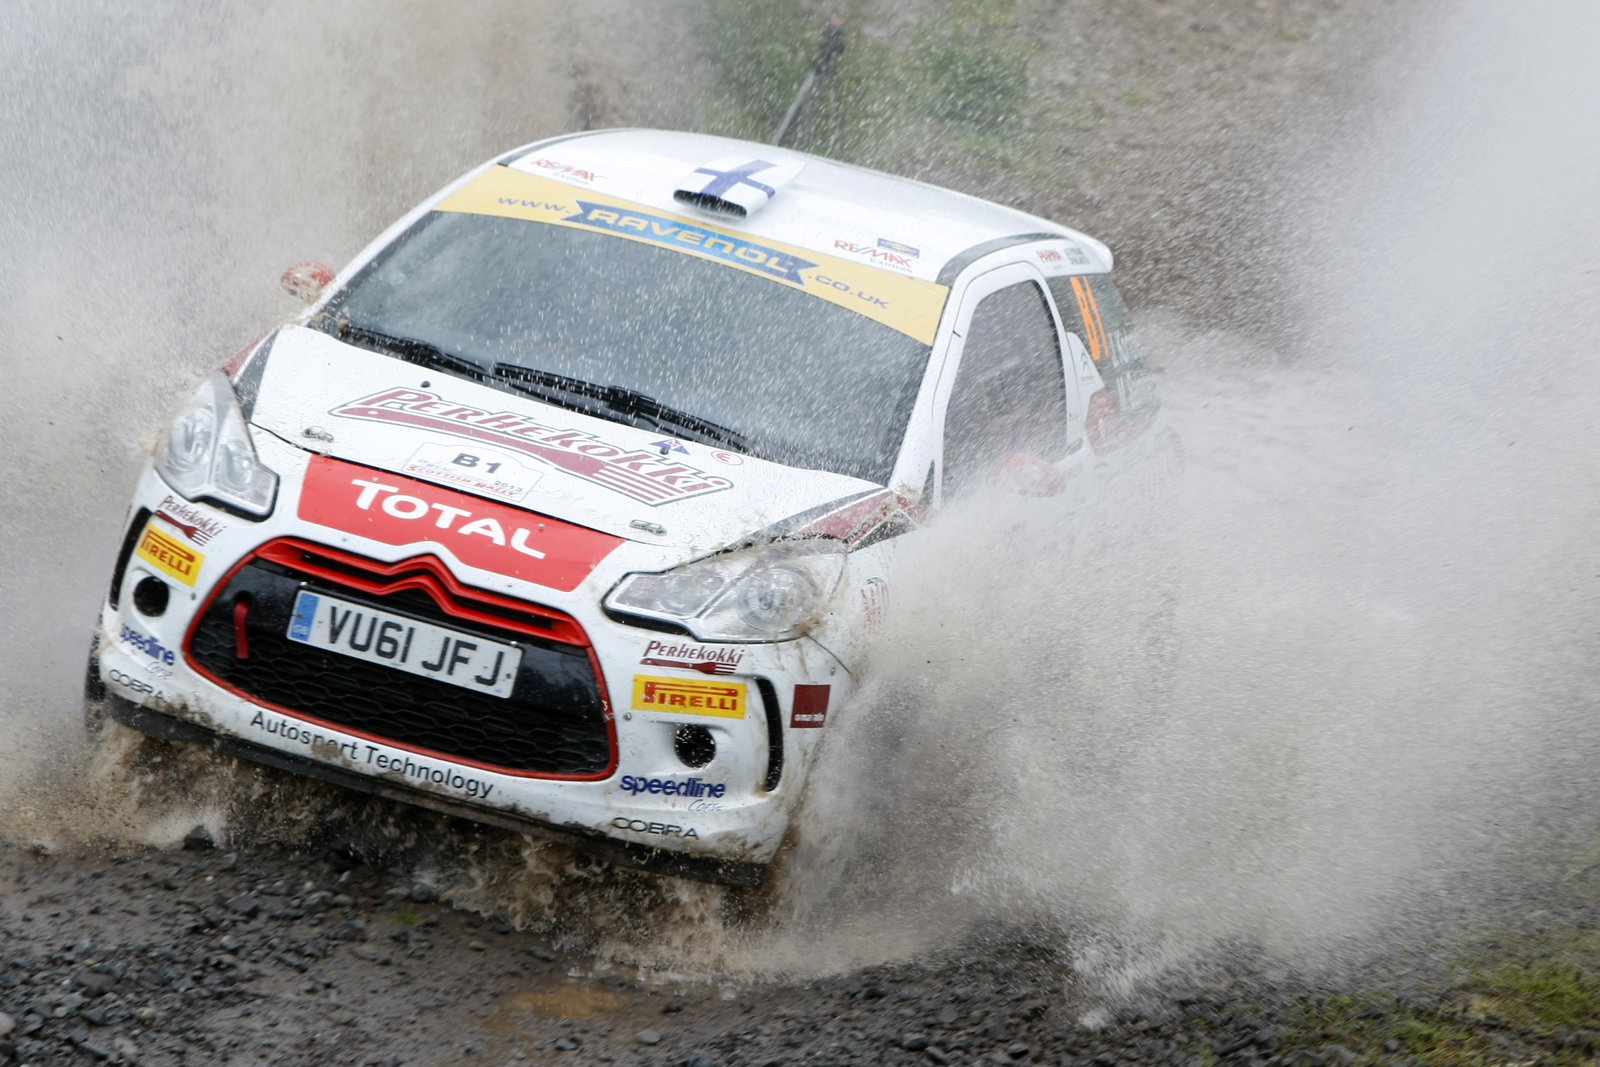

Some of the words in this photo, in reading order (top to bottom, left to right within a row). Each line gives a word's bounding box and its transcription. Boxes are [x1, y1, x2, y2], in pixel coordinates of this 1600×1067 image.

[586, 206, 793, 274] RAVENOL
[834, 239, 913, 268] RE/MAX
[451, 452, 503, 474] B1
[474, 481, 521, 497] RALLY
[493, 480, 523, 493] 2013
[351, 478, 546, 560] TOTAL
[140, 528, 196, 577] PIRELLI
[119, 623, 176, 667] speedline
[329, 605, 416, 664] VU61
[421, 636, 505, 687] JFJ
[108, 668, 168, 700] COBRA
[643, 680, 739, 712] PIRELLI
[364, 744, 495, 799] Technology
[619, 774, 727, 798] speedline
[611, 816, 700, 841] COBRA
